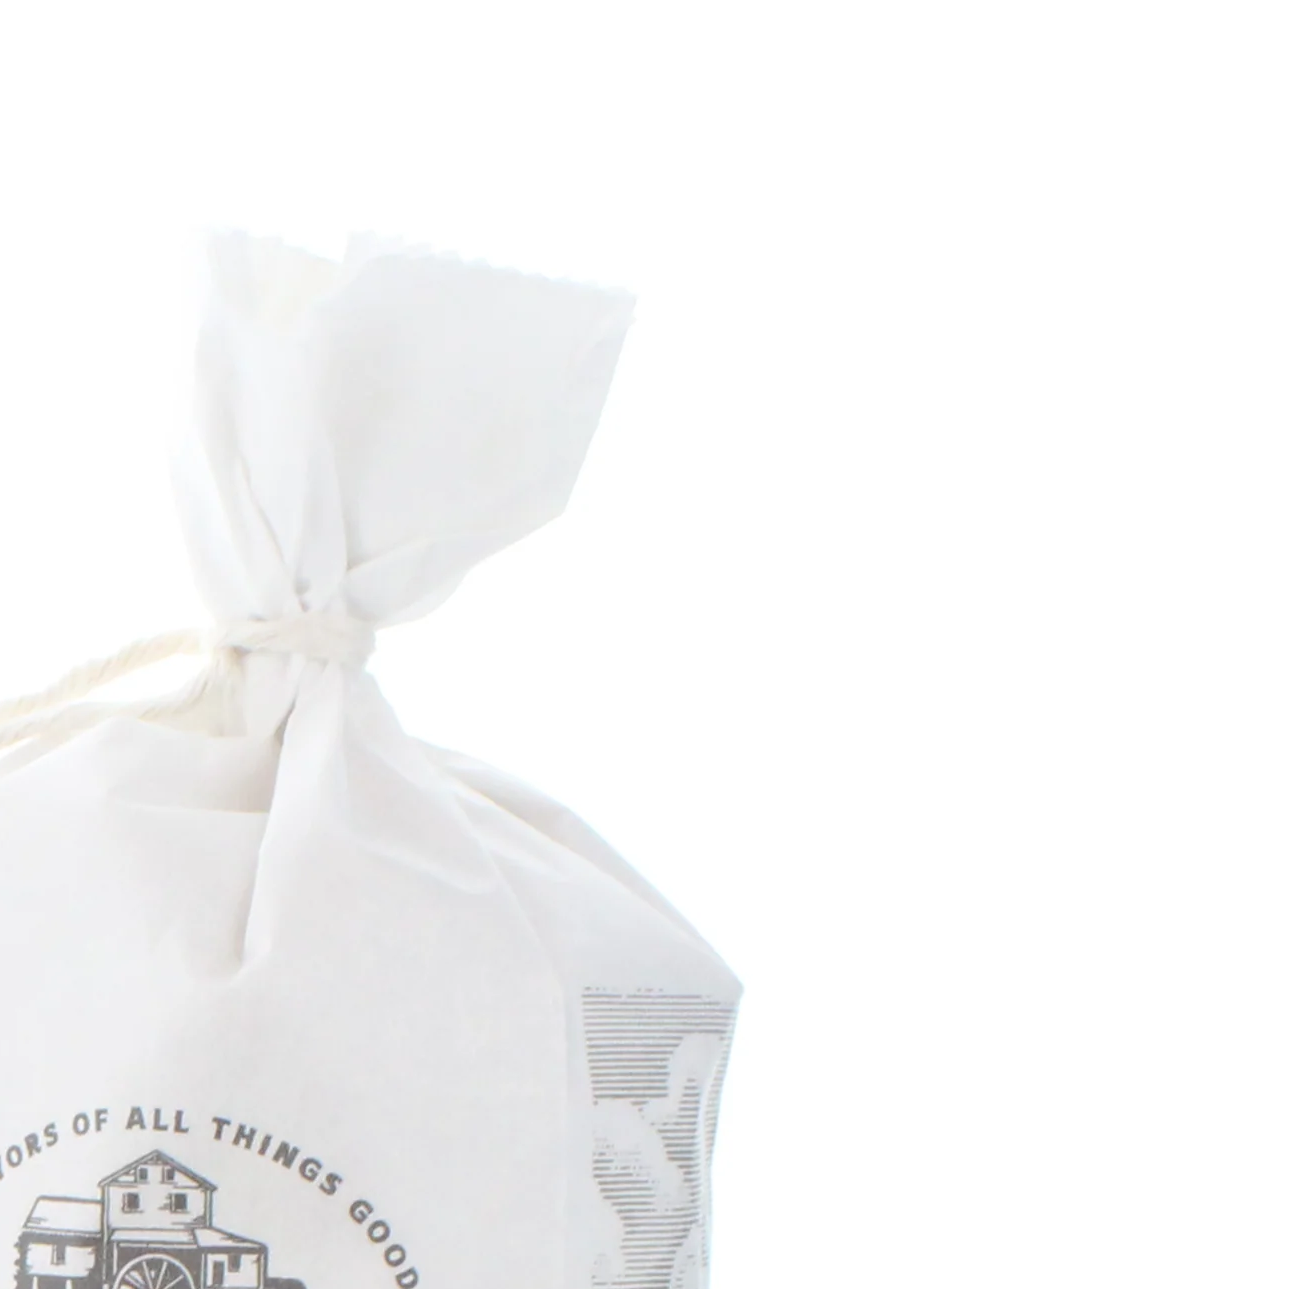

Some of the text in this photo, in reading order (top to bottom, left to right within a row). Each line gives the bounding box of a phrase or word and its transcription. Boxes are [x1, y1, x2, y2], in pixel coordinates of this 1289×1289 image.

[72, 1108, 109, 1137] OF
[125, 1105, 191, 1134] ALL
[211, 1117, 345, 1196] THINGS
